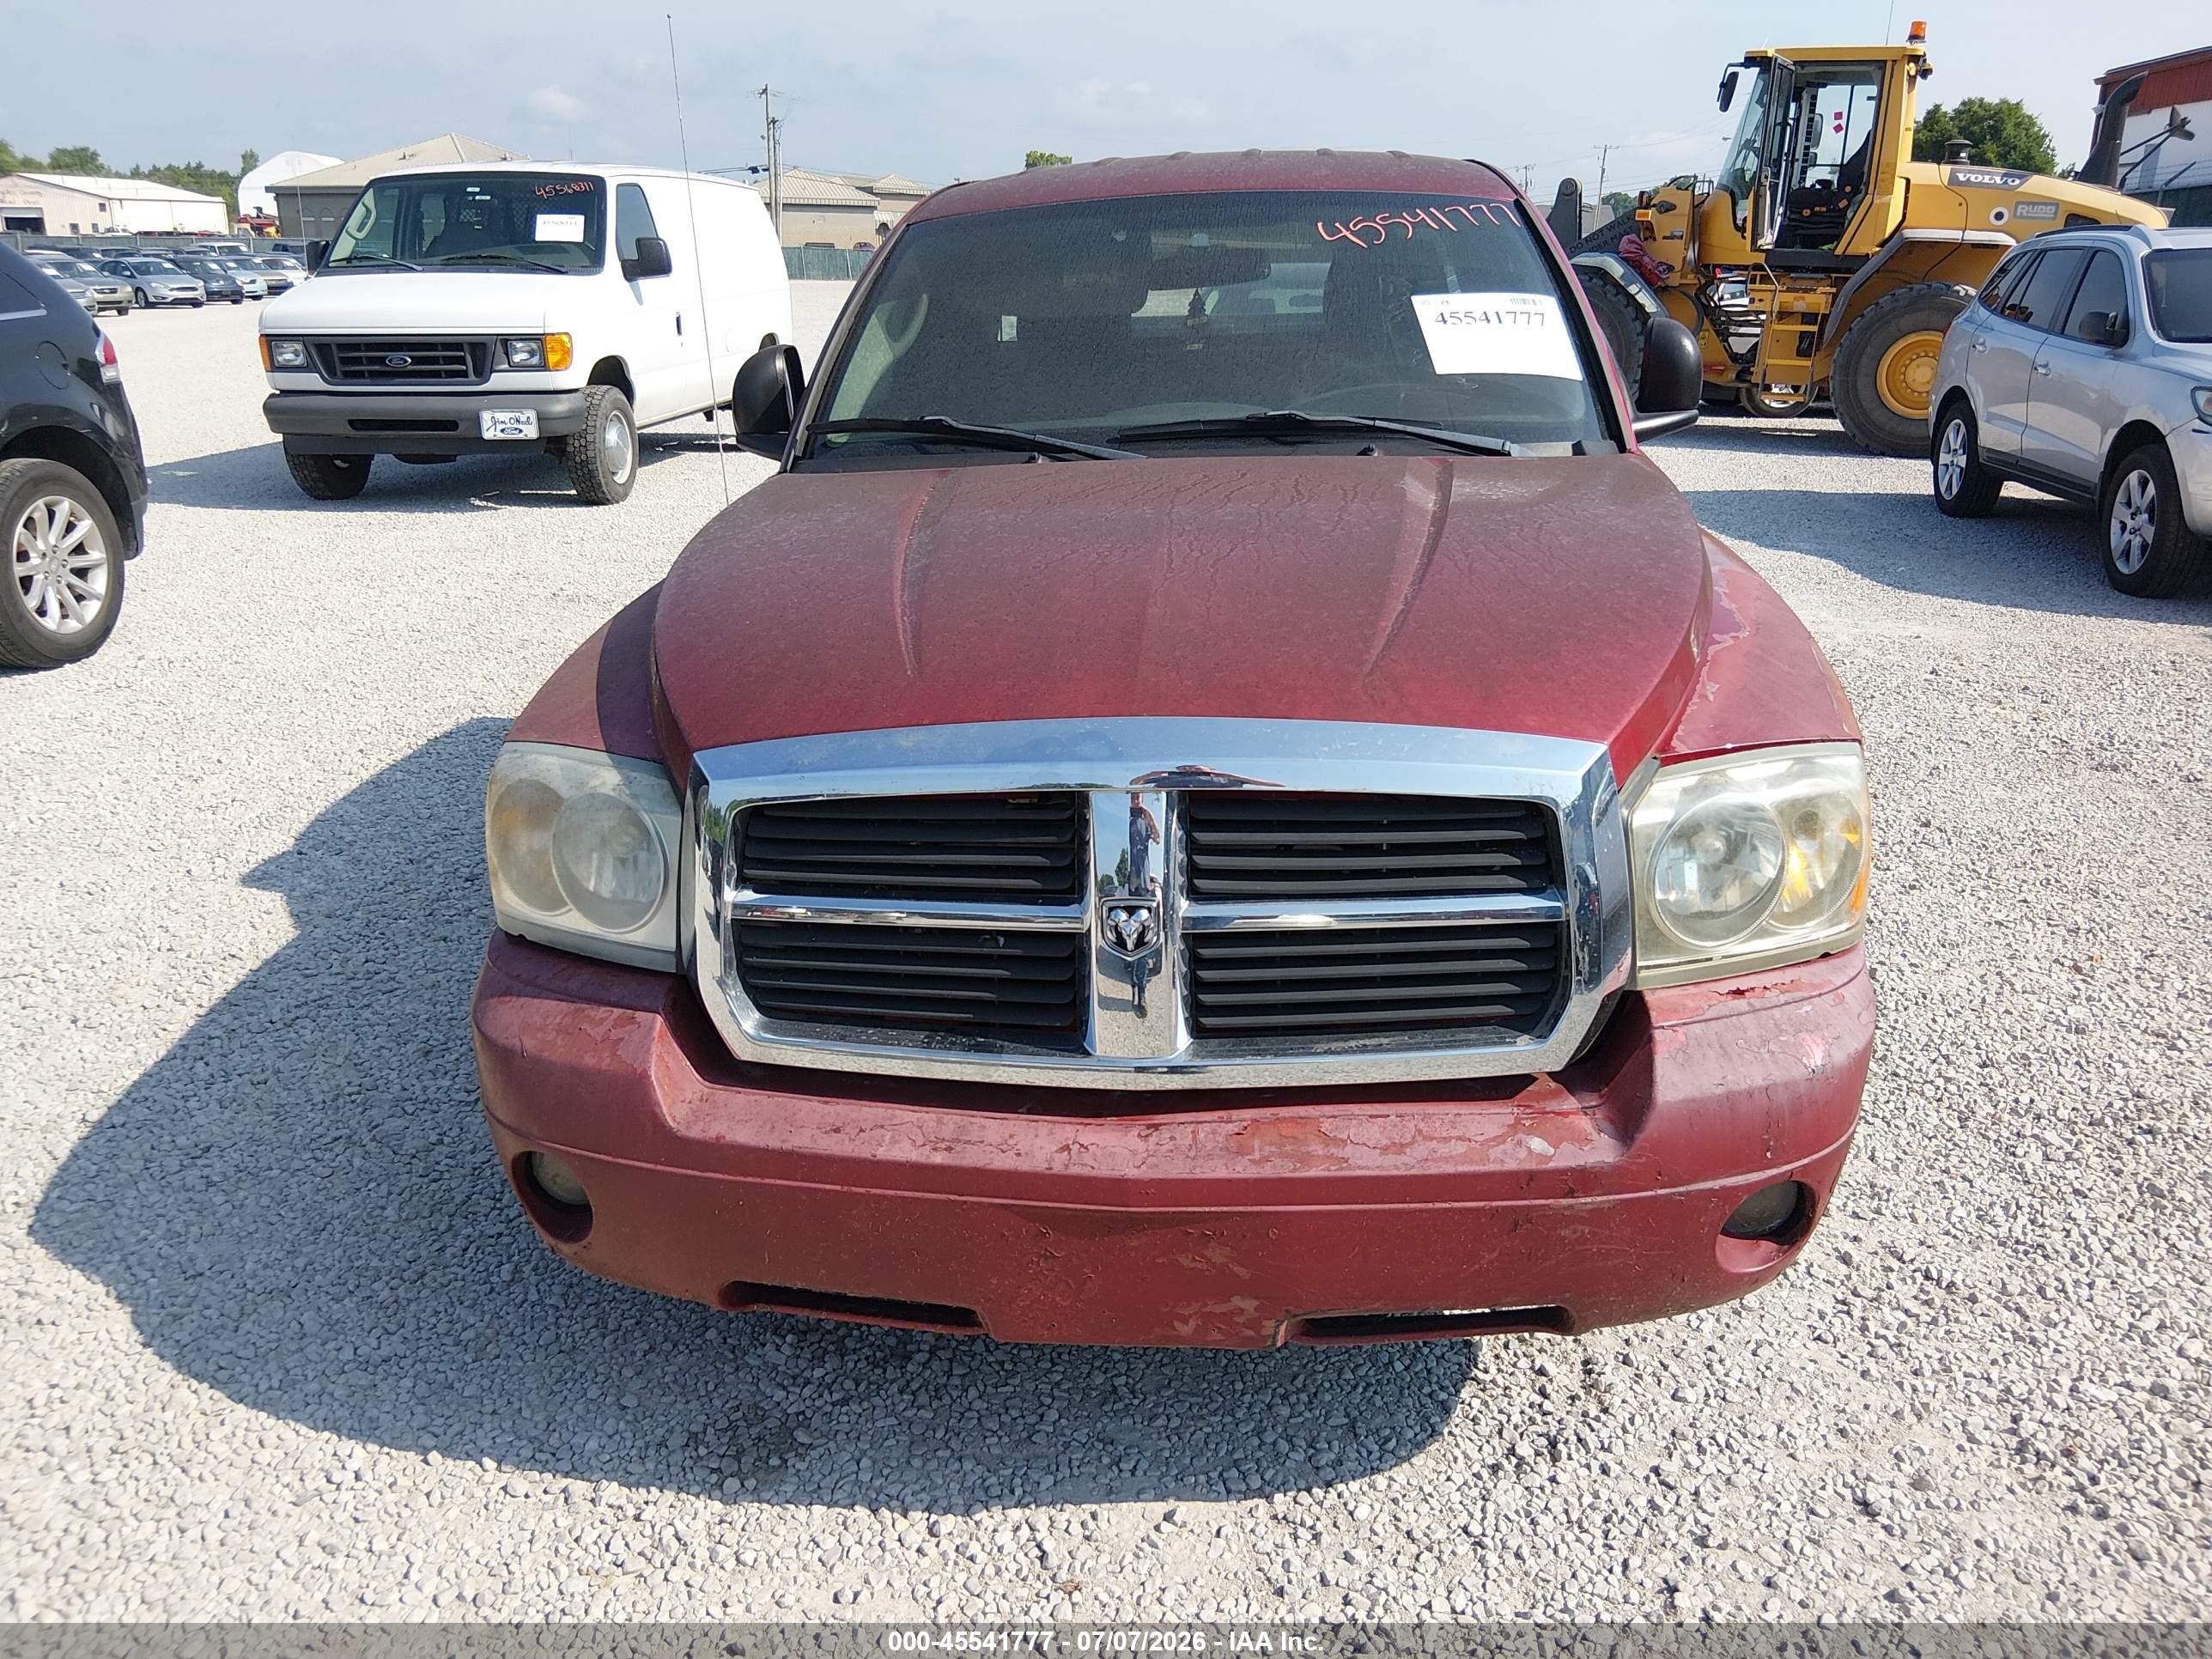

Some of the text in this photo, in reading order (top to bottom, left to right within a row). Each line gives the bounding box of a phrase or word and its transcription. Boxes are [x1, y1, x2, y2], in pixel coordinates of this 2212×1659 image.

[1956, 172, 2021, 185] VOLVO
[535, 181, 594, 199] 45568311
[1316, 203, 1522, 249] 45541777
[1569, 242, 1583, 254] DO
[1584, 229, 1605, 246] NOT
[1435, 310, 1545, 327] 45541777
[486, 416, 508, 433] Jim
